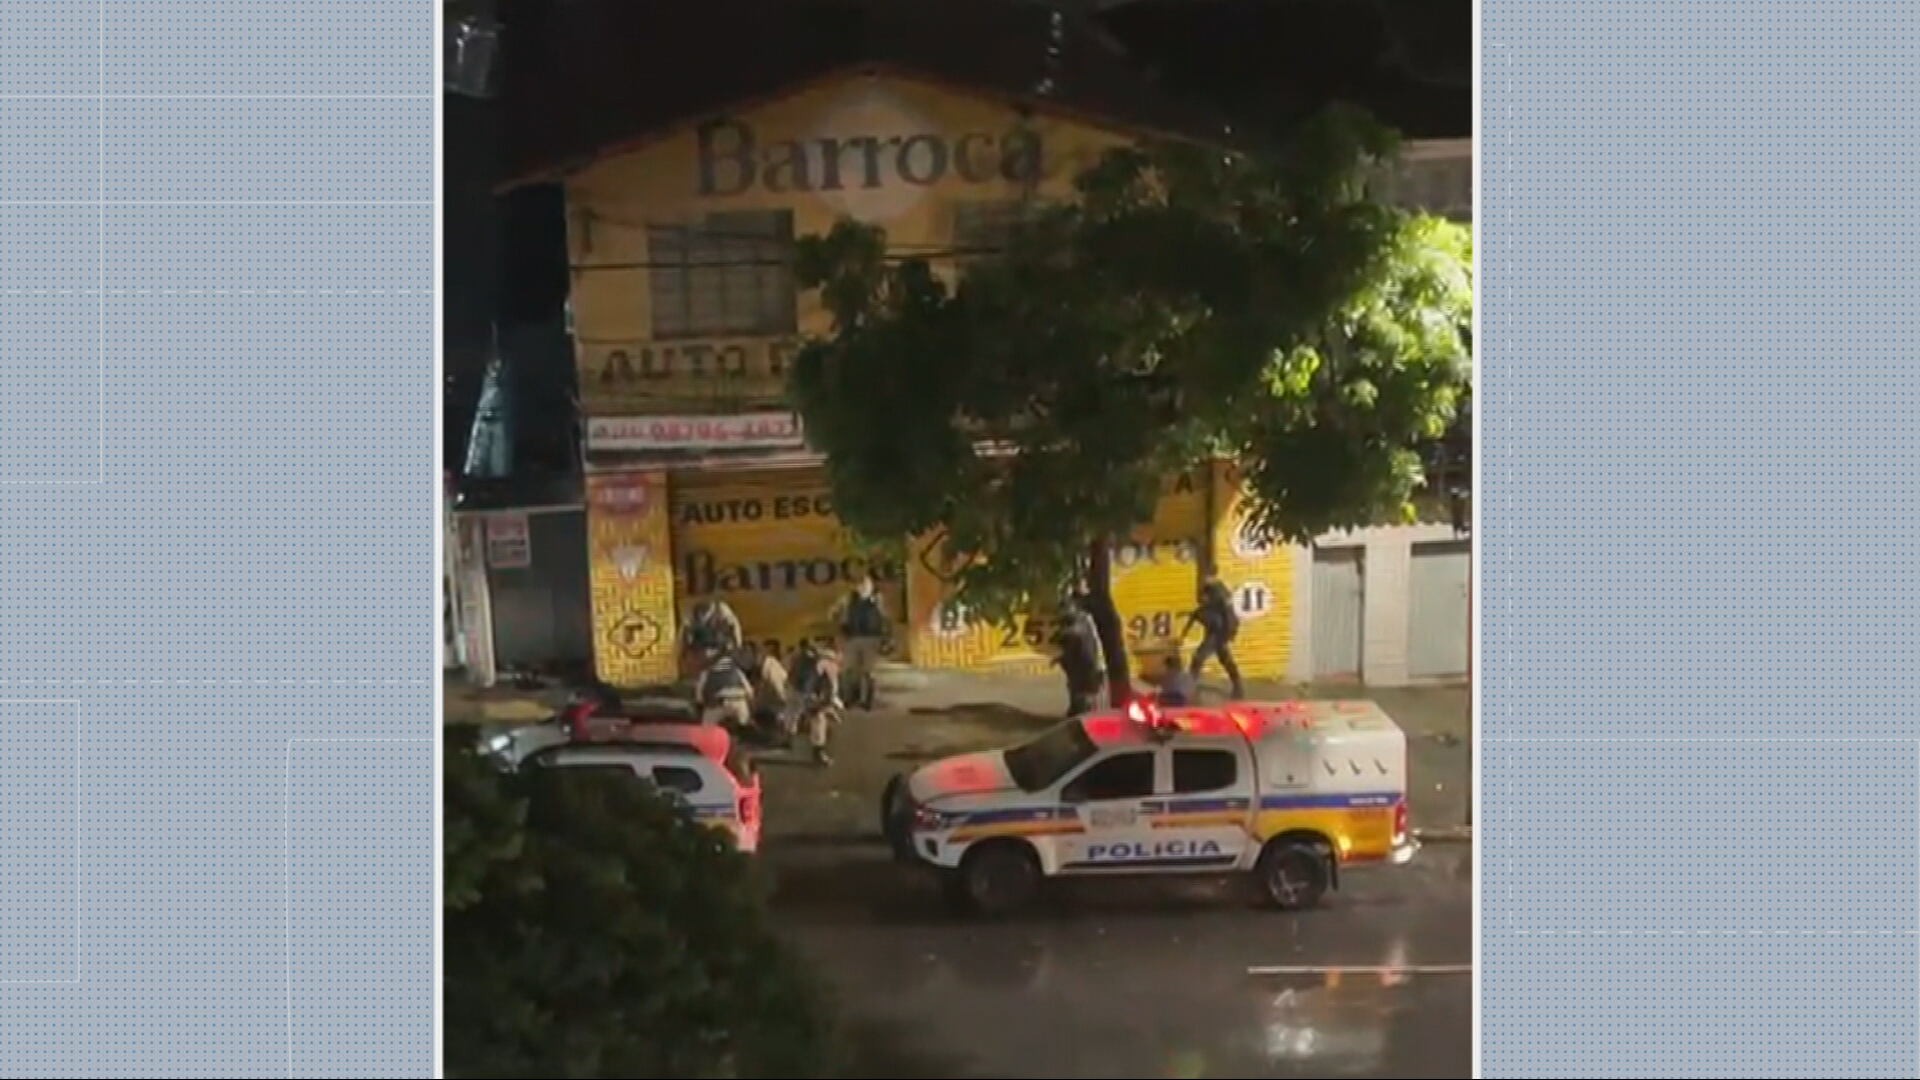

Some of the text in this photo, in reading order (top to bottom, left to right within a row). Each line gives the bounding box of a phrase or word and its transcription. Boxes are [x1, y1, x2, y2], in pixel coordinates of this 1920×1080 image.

[697, 114, 1047, 197] Barroca
[601, 343, 747, 383] AUTO
[681, 496, 833, 524] AUTO ESC
[683, 550, 899, 596] Barroca
